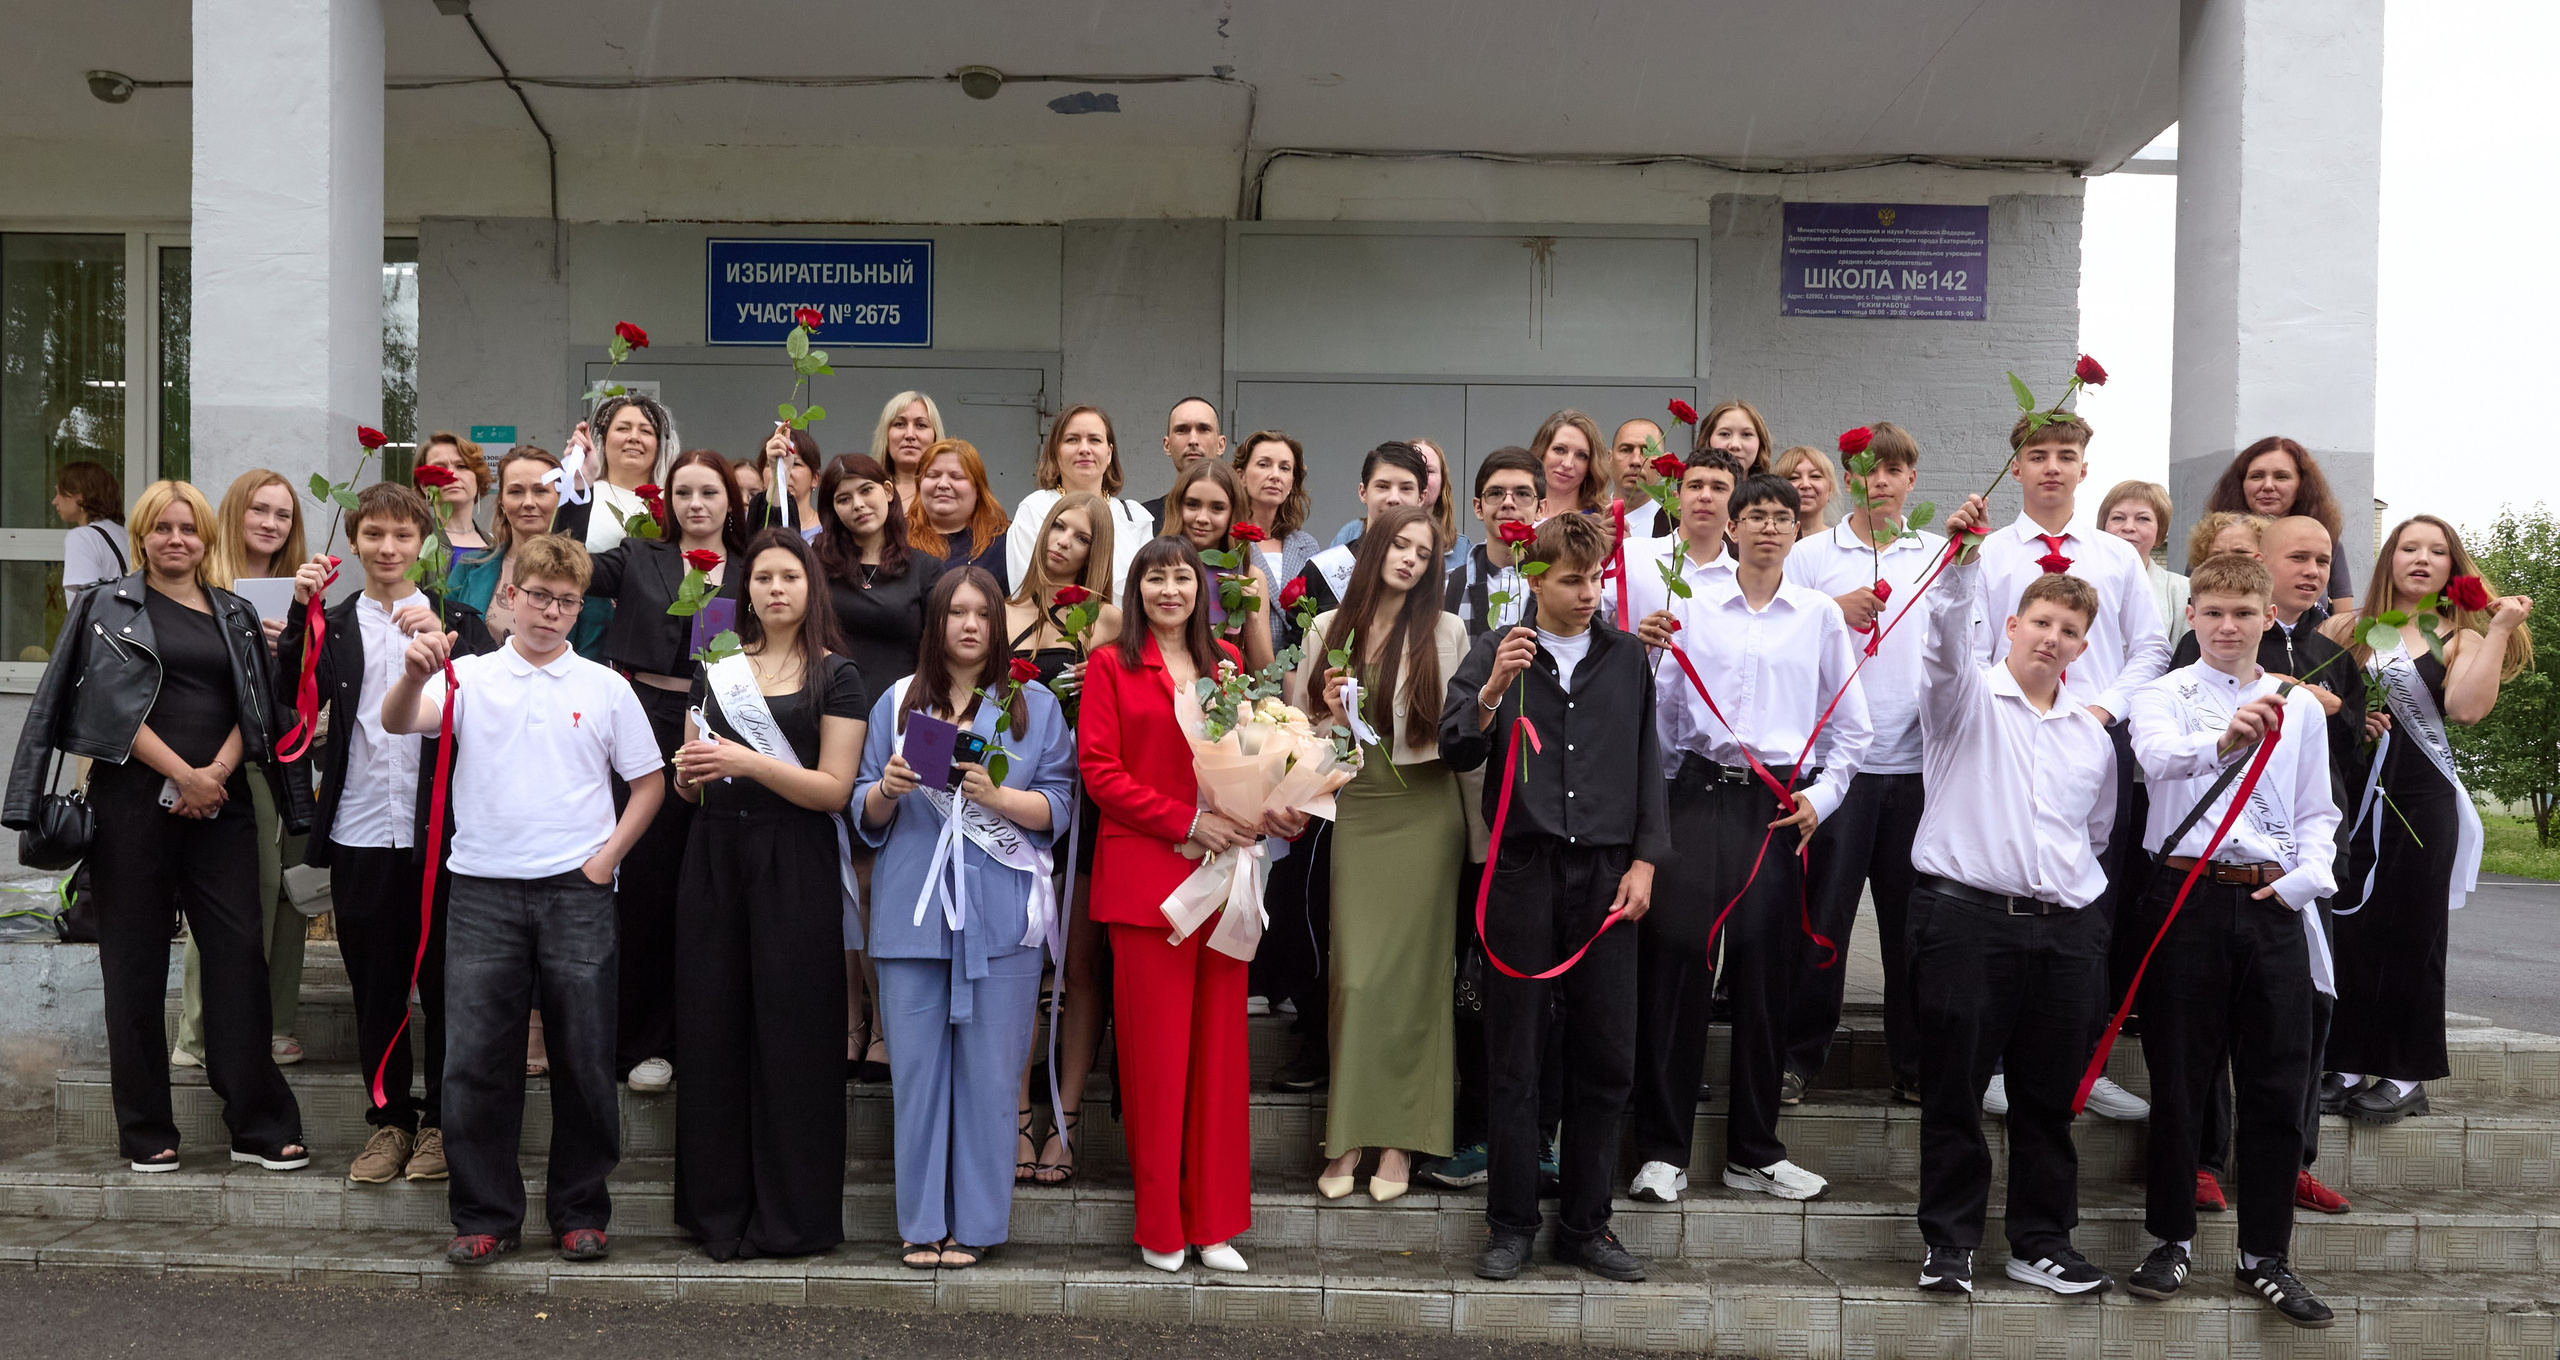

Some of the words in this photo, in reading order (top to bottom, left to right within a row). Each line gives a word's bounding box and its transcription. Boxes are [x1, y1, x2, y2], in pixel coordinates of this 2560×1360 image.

[1876, 249, 1944, 257] общеобразовательное
[726, 259, 914, 284] ИЗБИРАТЕЛЬНЫЙ
[1805, 268, 1894, 289] ШКОЛА
[1902, 270, 1968, 290] №142
[830, 304, 852, 324] №
[855, 304, 902, 325] 2675
[973, 817, 1024, 855] 2026
